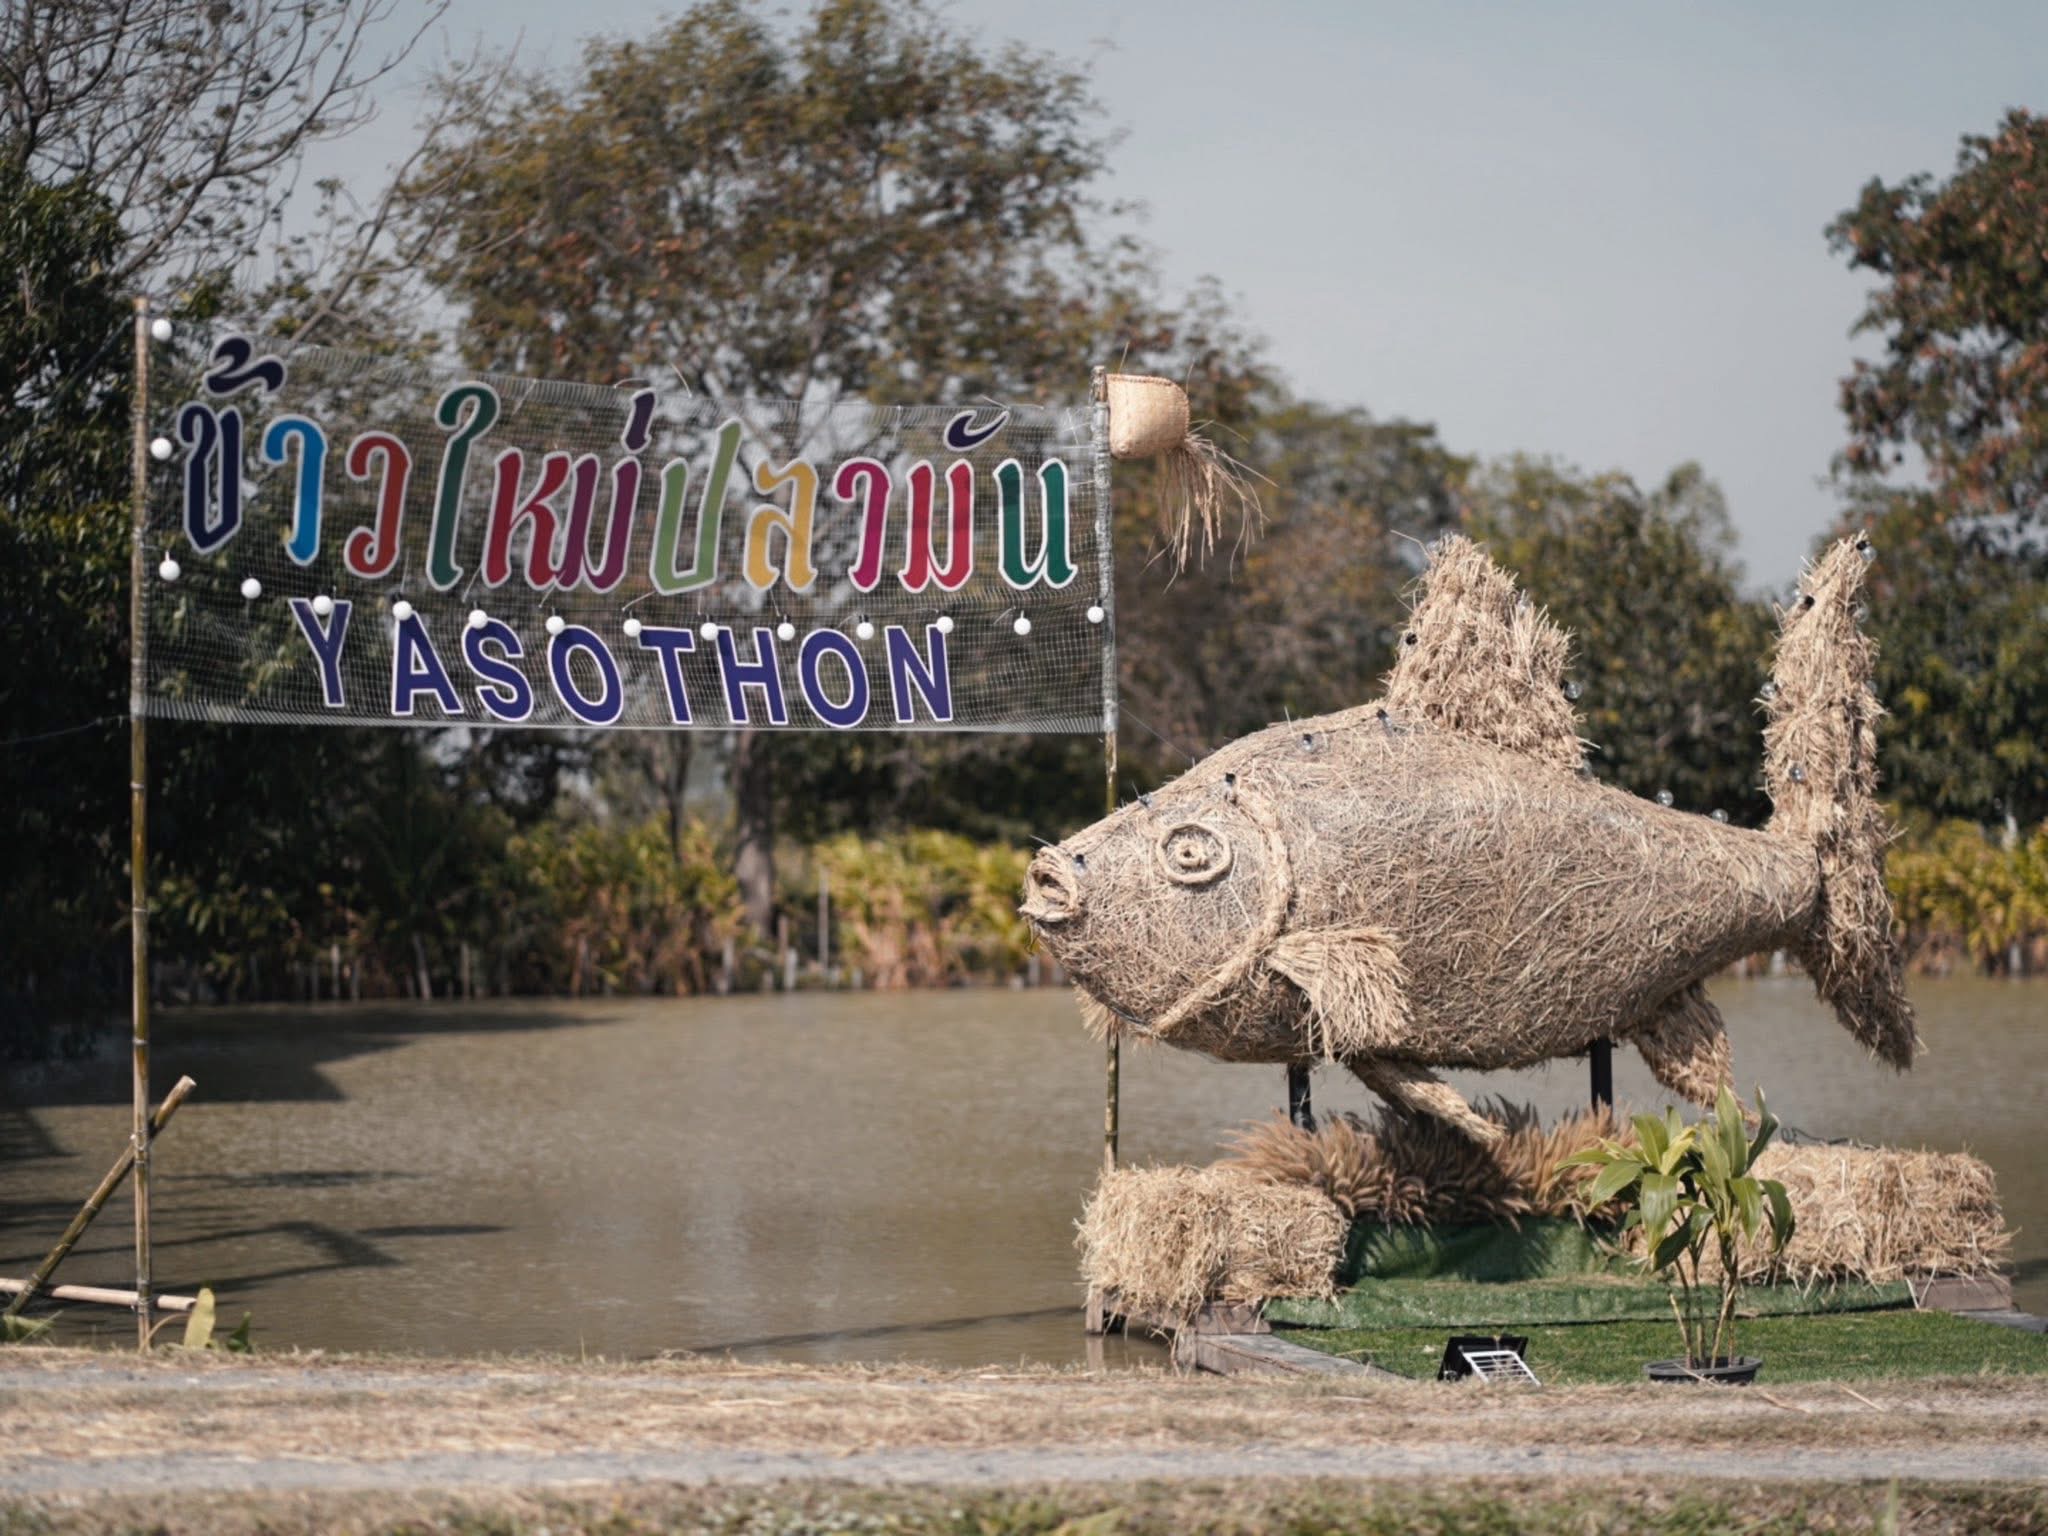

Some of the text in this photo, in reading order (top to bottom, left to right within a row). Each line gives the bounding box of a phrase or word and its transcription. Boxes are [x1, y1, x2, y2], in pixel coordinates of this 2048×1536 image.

[176, 334, 1078, 594] ข้าวใหม่ปลามัน
[288, 598, 953, 728] YASOTHON
